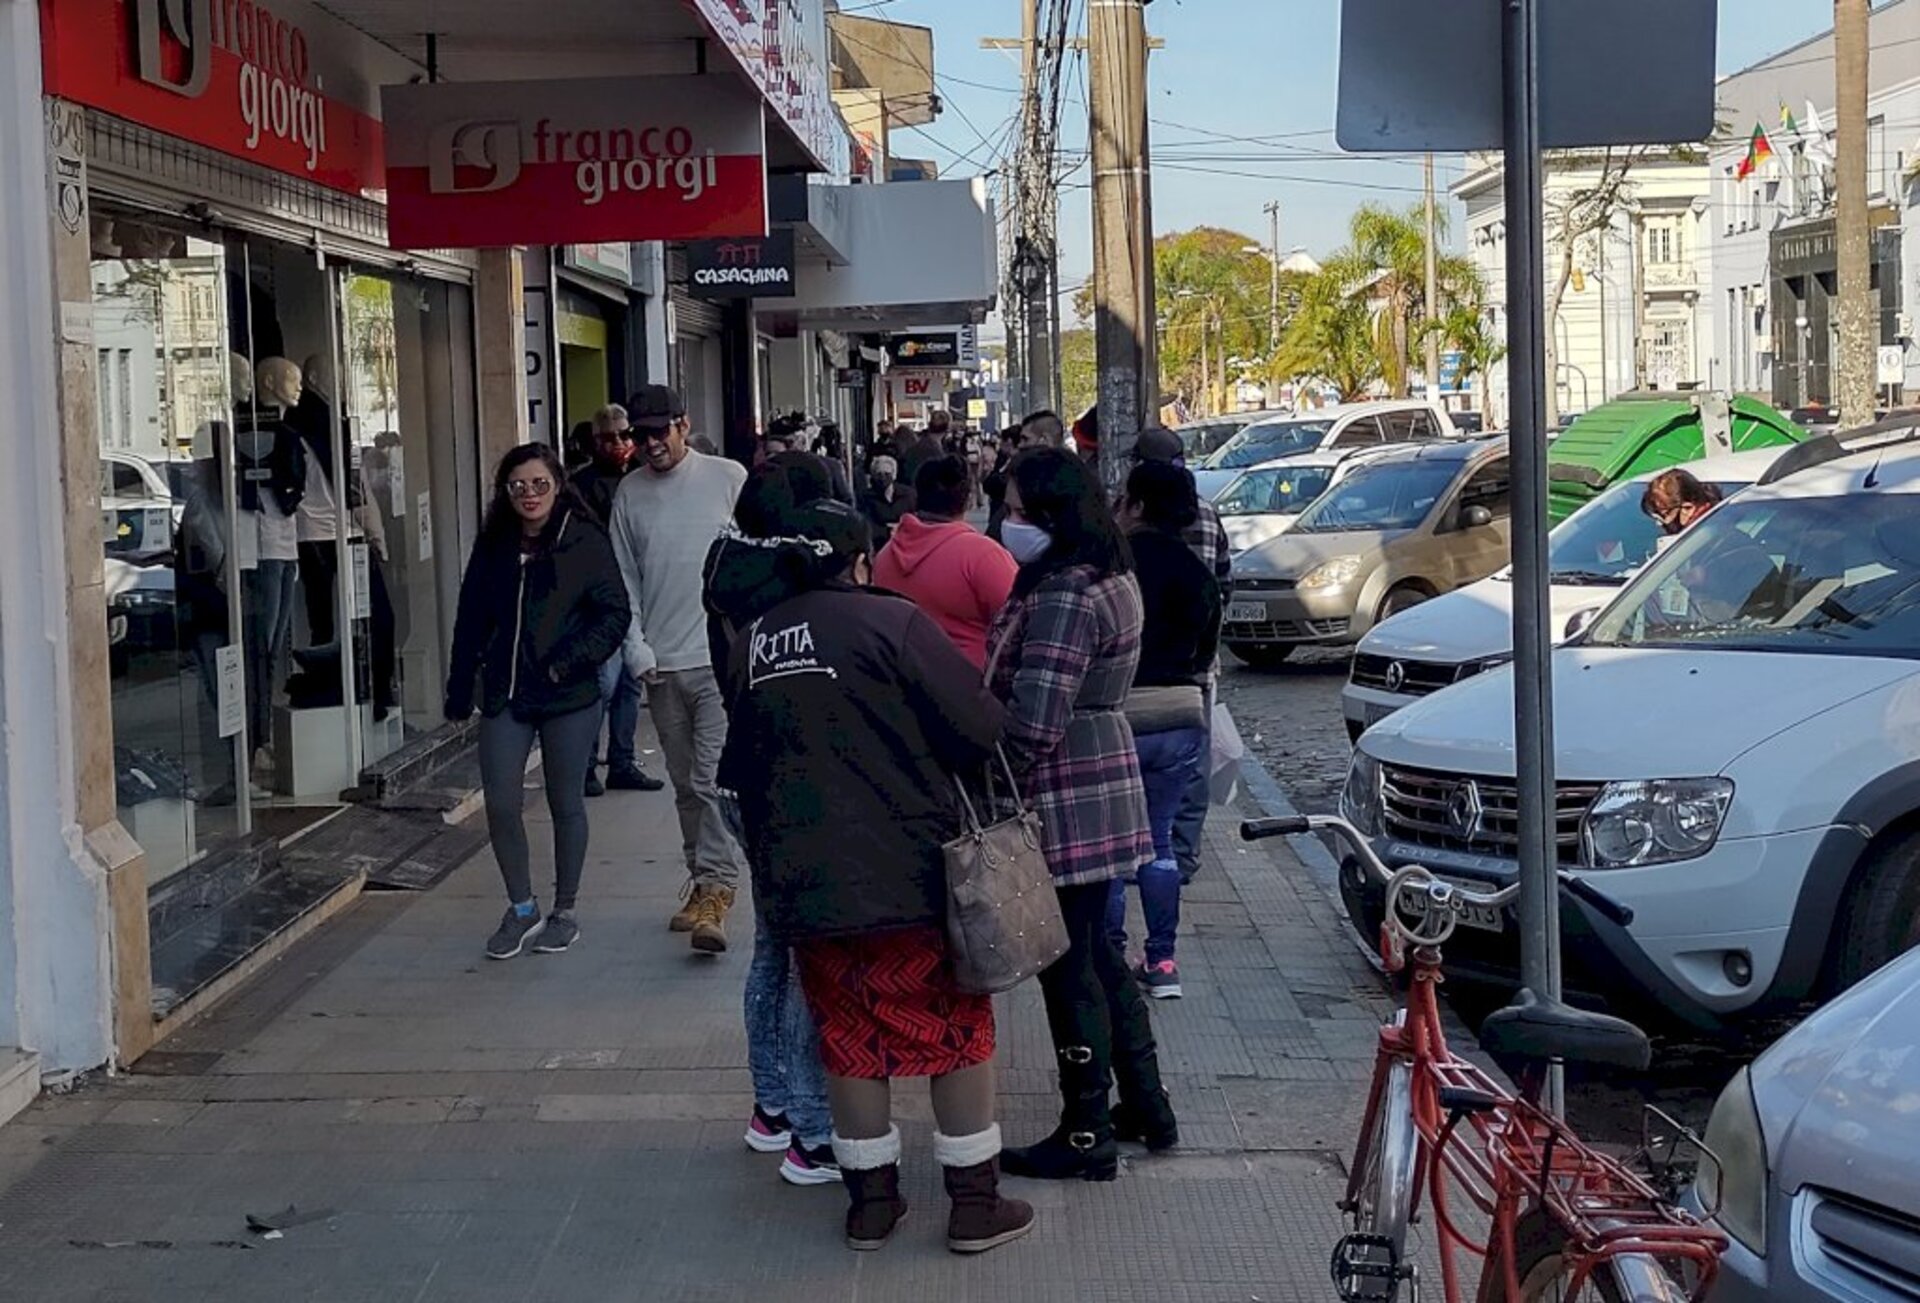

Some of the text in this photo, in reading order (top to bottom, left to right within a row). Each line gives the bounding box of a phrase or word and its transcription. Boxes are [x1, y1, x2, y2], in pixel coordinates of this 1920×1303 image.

[240, 62, 325, 171] giorgi
[534, 118, 692, 162] franco
[576, 148, 717, 205] giorgi
[695, 266, 789, 286] CASACHINA
[905, 379, 930, 394] BV
[753, 621, 815, 666] RITTA
